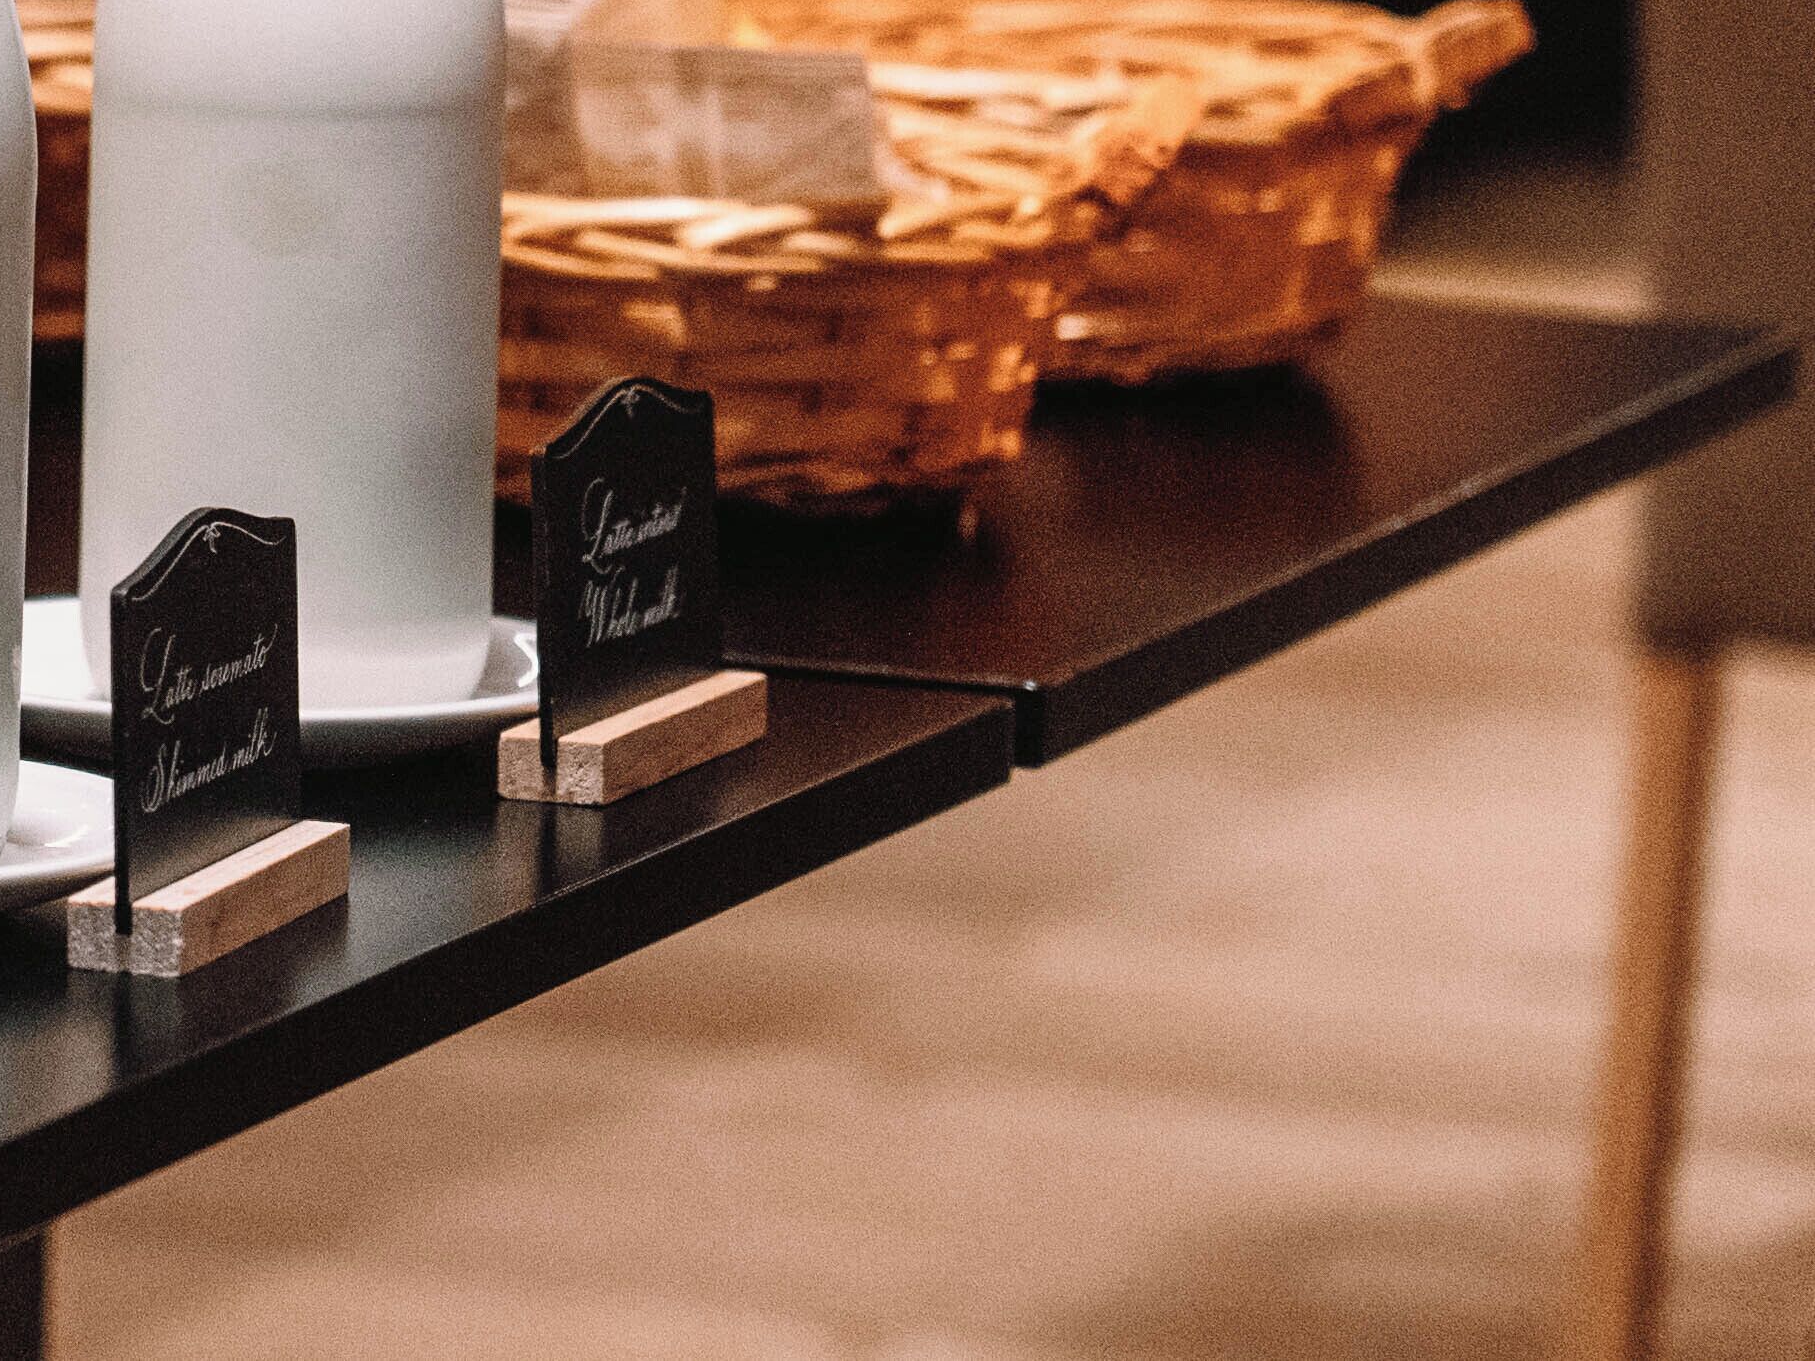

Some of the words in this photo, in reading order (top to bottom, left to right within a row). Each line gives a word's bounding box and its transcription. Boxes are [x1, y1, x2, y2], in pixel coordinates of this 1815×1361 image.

[581, 477, 634, 574] Latte
[140, 627, 197, 725] Latte
[199, 623, 278, 697] scremato
[140, 740, 227, 813] Skimmed
[229, 707, 278, 770] milk
